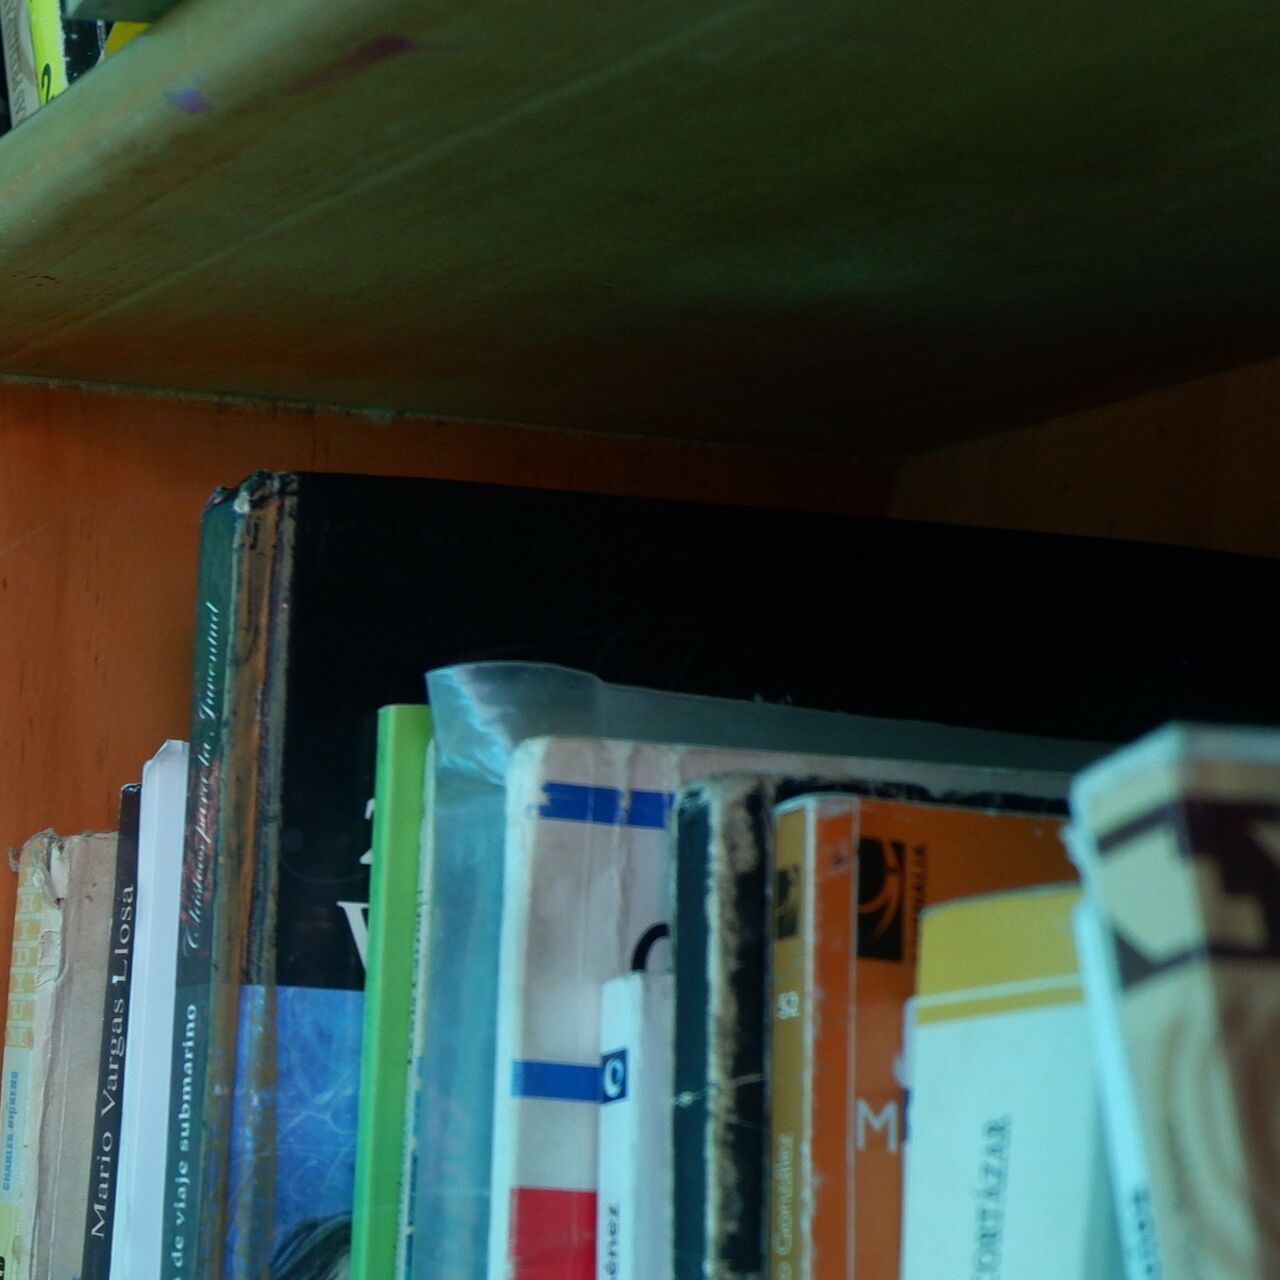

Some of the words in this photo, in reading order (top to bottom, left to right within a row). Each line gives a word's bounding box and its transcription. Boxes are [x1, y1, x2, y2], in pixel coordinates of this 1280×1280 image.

[111, 885, 135, 986] Llosa
[100, 997, 126, 1117] Vargas
[178, 1004, 197, 1152] submarino
[2, 1133, 16, 1192] CHARLES
[91, 1129, 114, 1240] Mario
[173, 1160, 191, 1225] viaje
[171, 1235, 184, 1268] de
